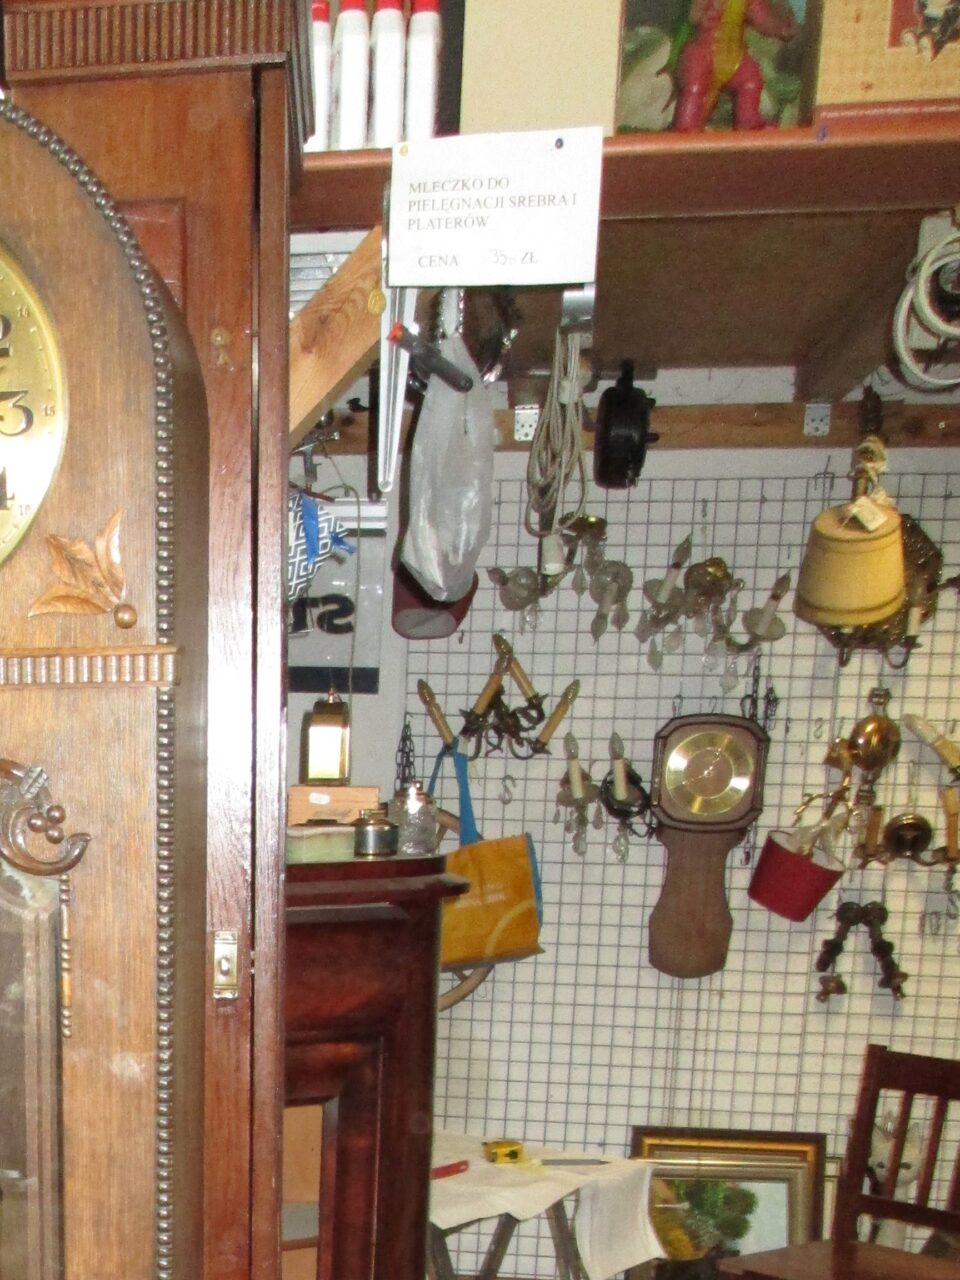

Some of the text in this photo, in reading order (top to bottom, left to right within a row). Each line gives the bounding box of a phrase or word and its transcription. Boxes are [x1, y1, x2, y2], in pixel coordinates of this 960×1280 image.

[408, 176, 510, 194] MLECZKO DO
[407, 193, 577, 213] PIELĘGNACJI SREBRA I
[407, 214, 490, 231] PLATERÓW
[417, 255, 460, 269] CENA
